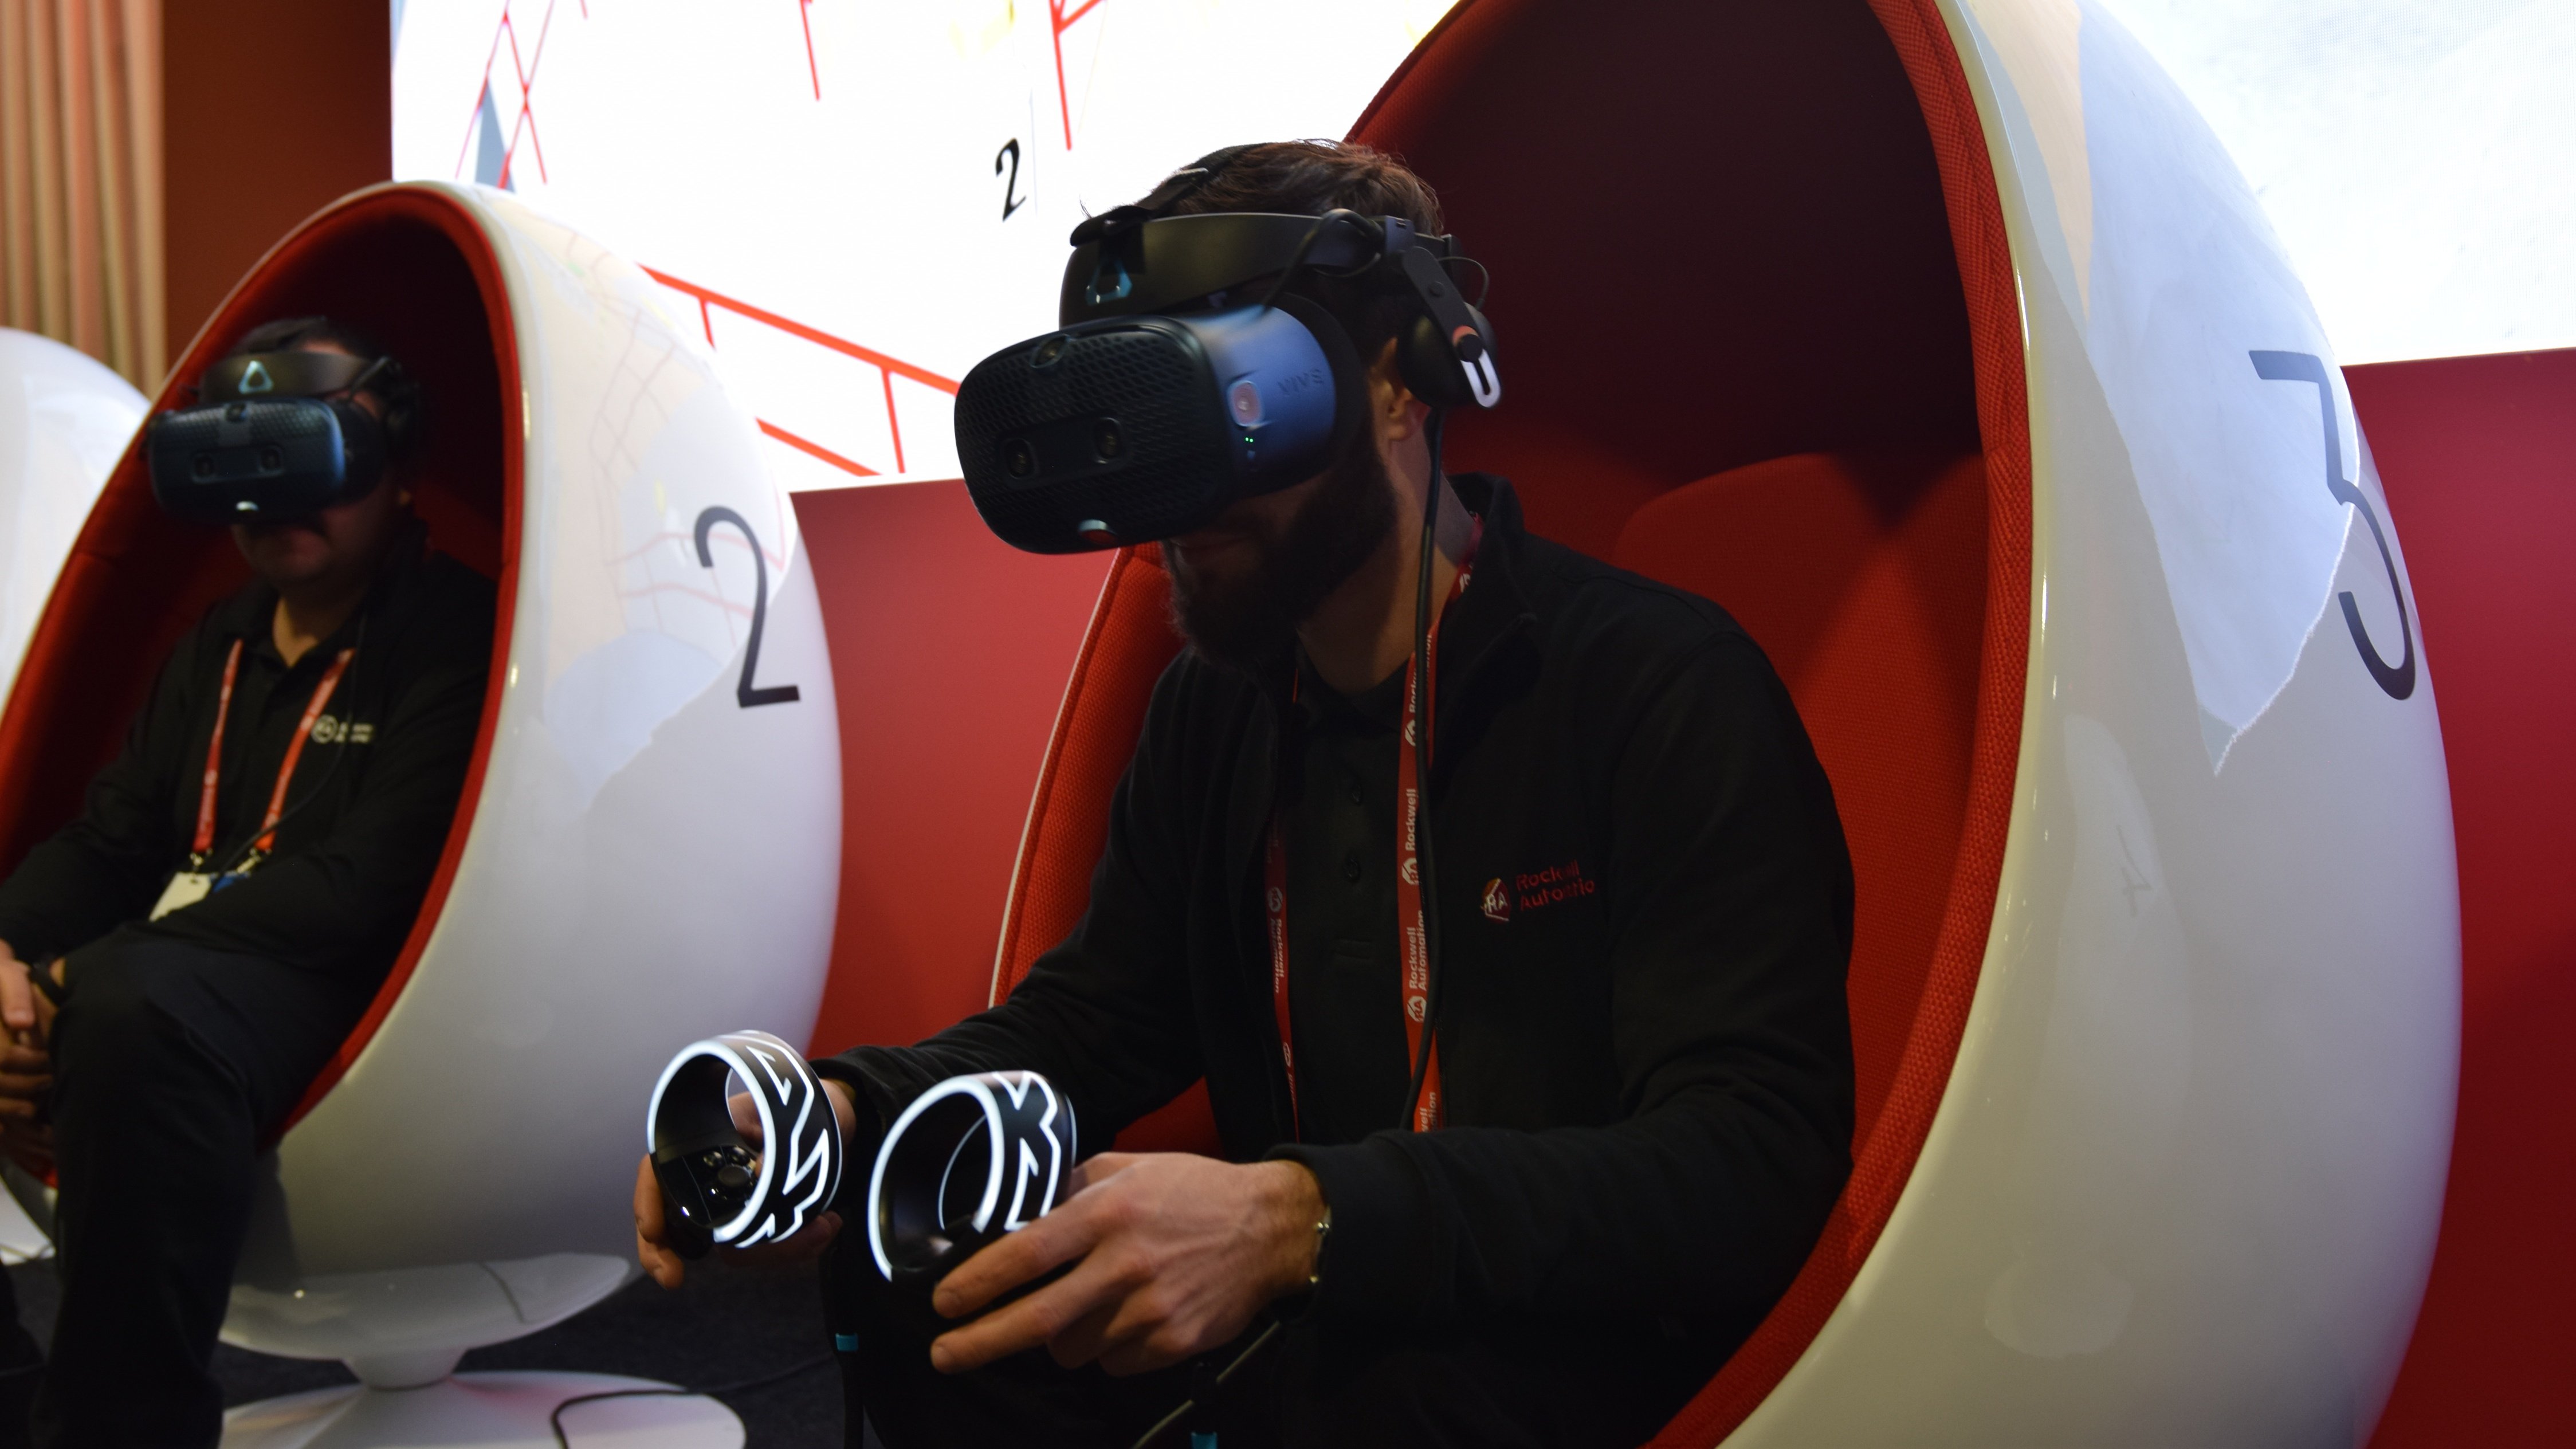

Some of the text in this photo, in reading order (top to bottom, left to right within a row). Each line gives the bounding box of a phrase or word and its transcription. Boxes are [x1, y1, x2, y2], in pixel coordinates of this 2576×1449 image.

[995, 137, 1026, 222] 2
[2248, 350, 2416, 700] 3
[694, 505, 800, 709] 2
[1275, 918, 1285, 977] Rockwell
[1407, 926, 1417, 989] Rockwell
[1417, 909, 1427, 991] Automation
